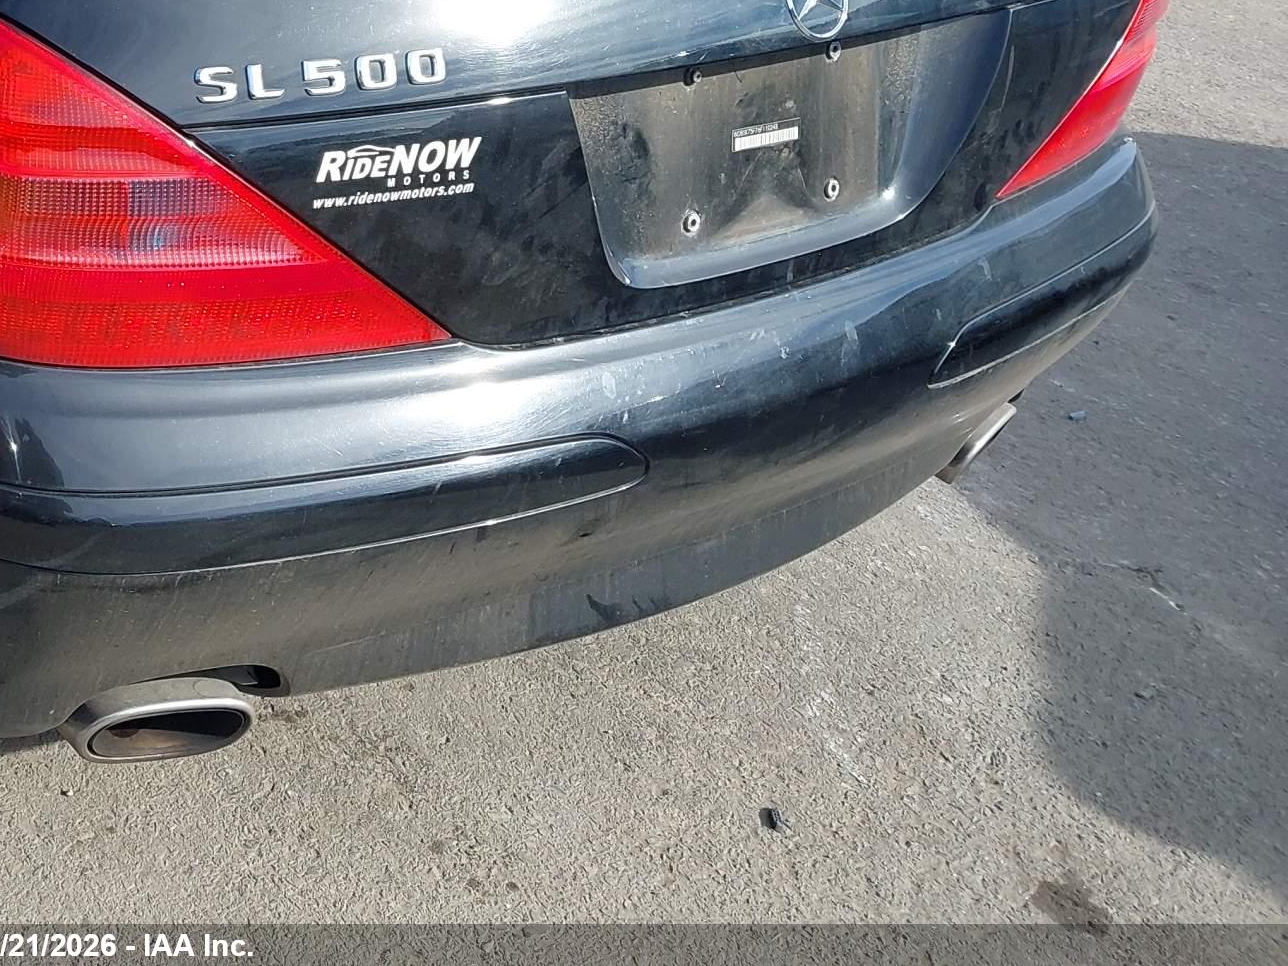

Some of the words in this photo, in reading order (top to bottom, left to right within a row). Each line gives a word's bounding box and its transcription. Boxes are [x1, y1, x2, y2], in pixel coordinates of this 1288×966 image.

[301, 48, 447, 96] 500
[387, 171, 471, 188] MOTORS
[312, 183, 475, 209] www.ridenowmotors.com
